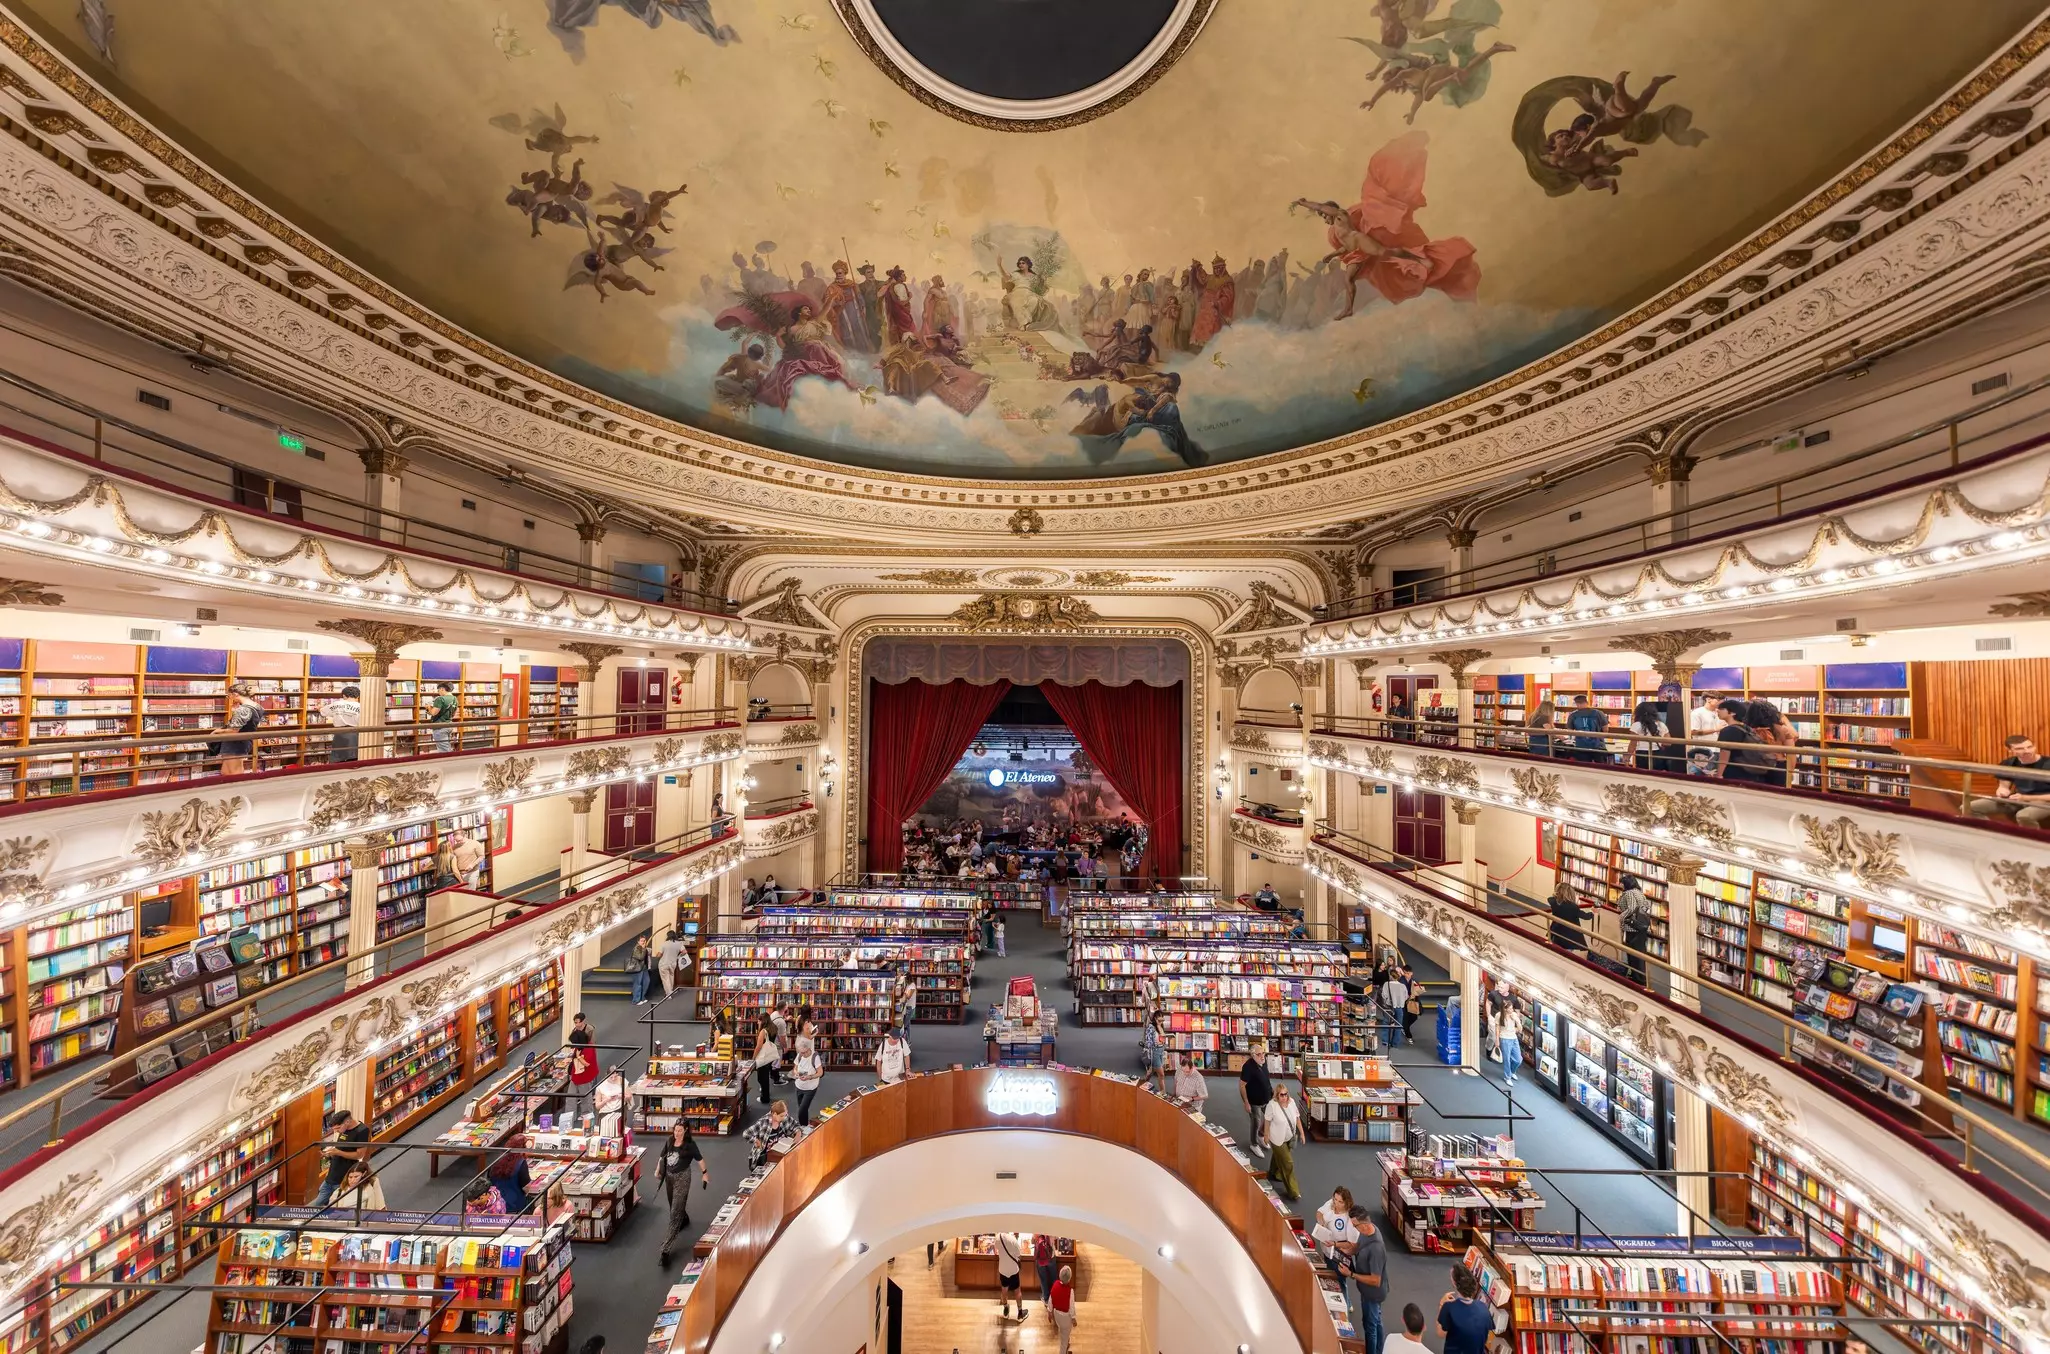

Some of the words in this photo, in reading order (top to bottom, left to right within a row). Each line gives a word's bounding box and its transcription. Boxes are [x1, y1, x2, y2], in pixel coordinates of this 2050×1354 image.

[1005, 772, 1018, 783] El
[1019, 773, 1056, 783] Ateneo
[1514, 1235, 1556, 1244] BOGRAFÍAS
